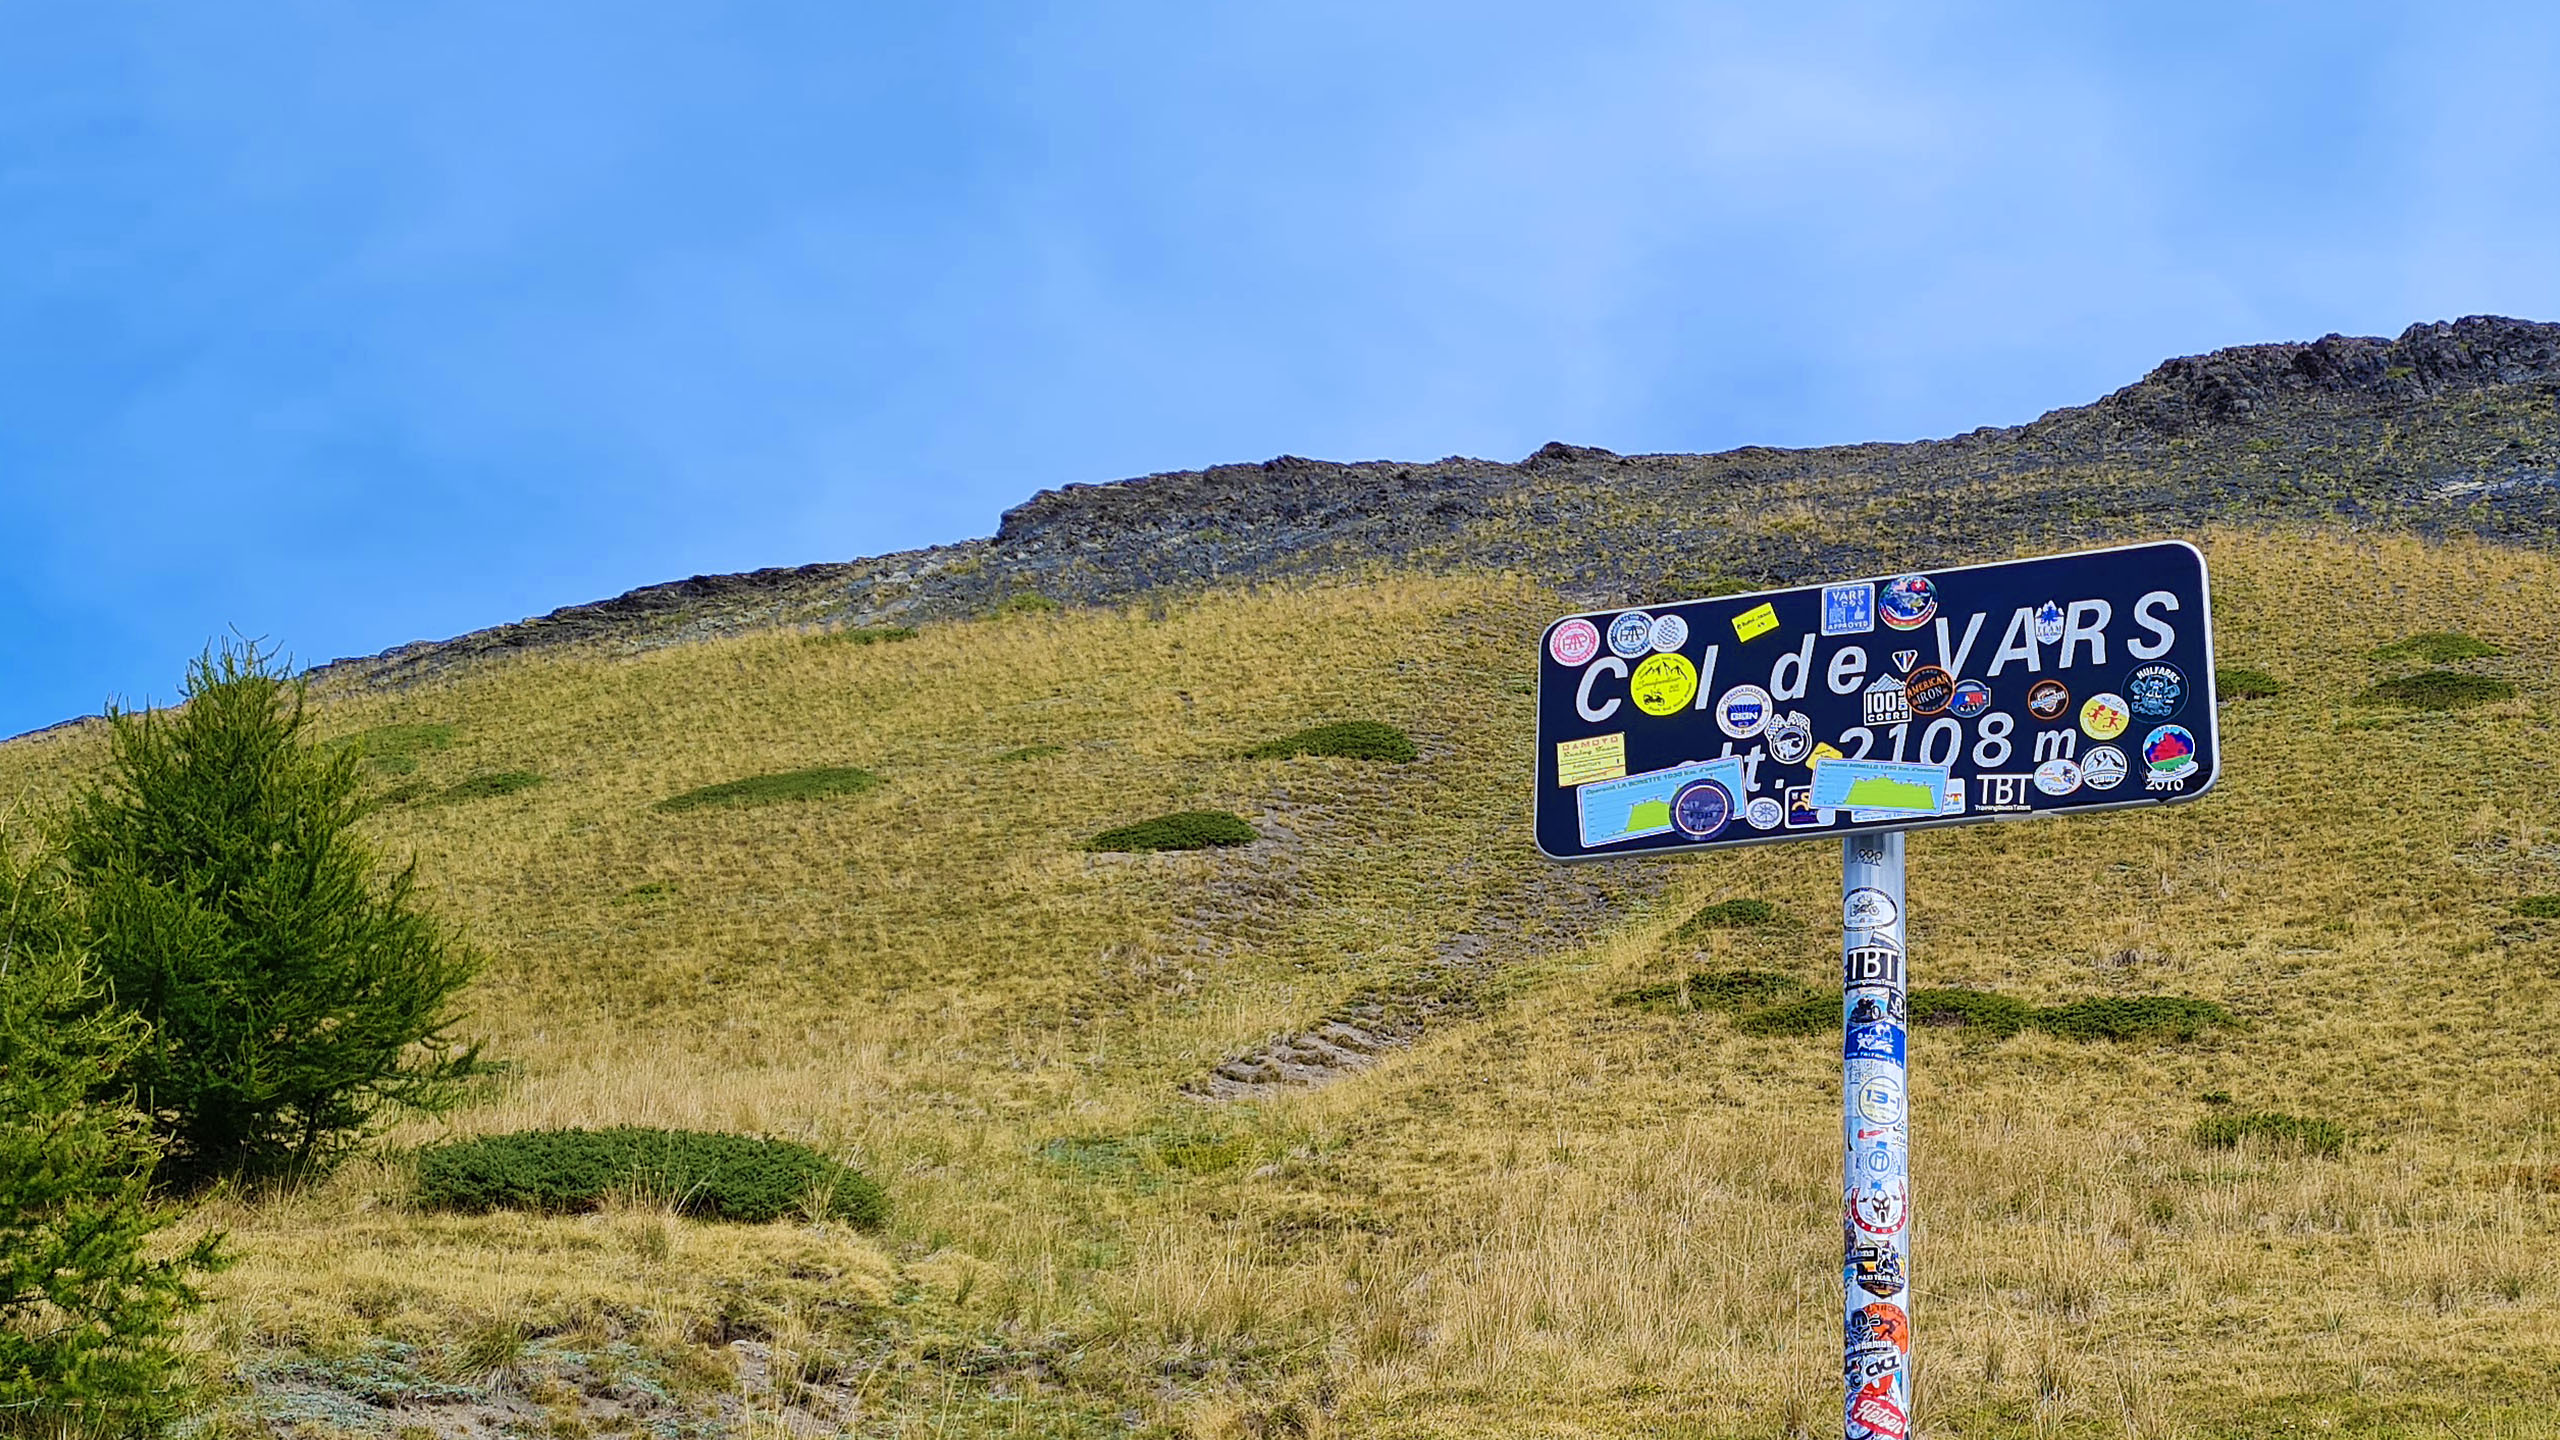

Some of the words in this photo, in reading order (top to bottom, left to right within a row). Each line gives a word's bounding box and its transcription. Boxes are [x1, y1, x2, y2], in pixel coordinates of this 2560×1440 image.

[1828, 620, 1869, 631] APPROVED
[1576, 645, 1719, 723] Cl
[1770, 633, 1868, 701] de
[1935, 590, 2180, 681] VARS
[1906, 673, 1950, 698] AMERICAN
[1916, 686, 1944, 704] IRON
[1839, 711, 2015, 769] 2108
[2033, 728, 2077, 763] m
[1976, 773, 2033, 805] TBT
[1848, 948, 1898, 980] TBT
